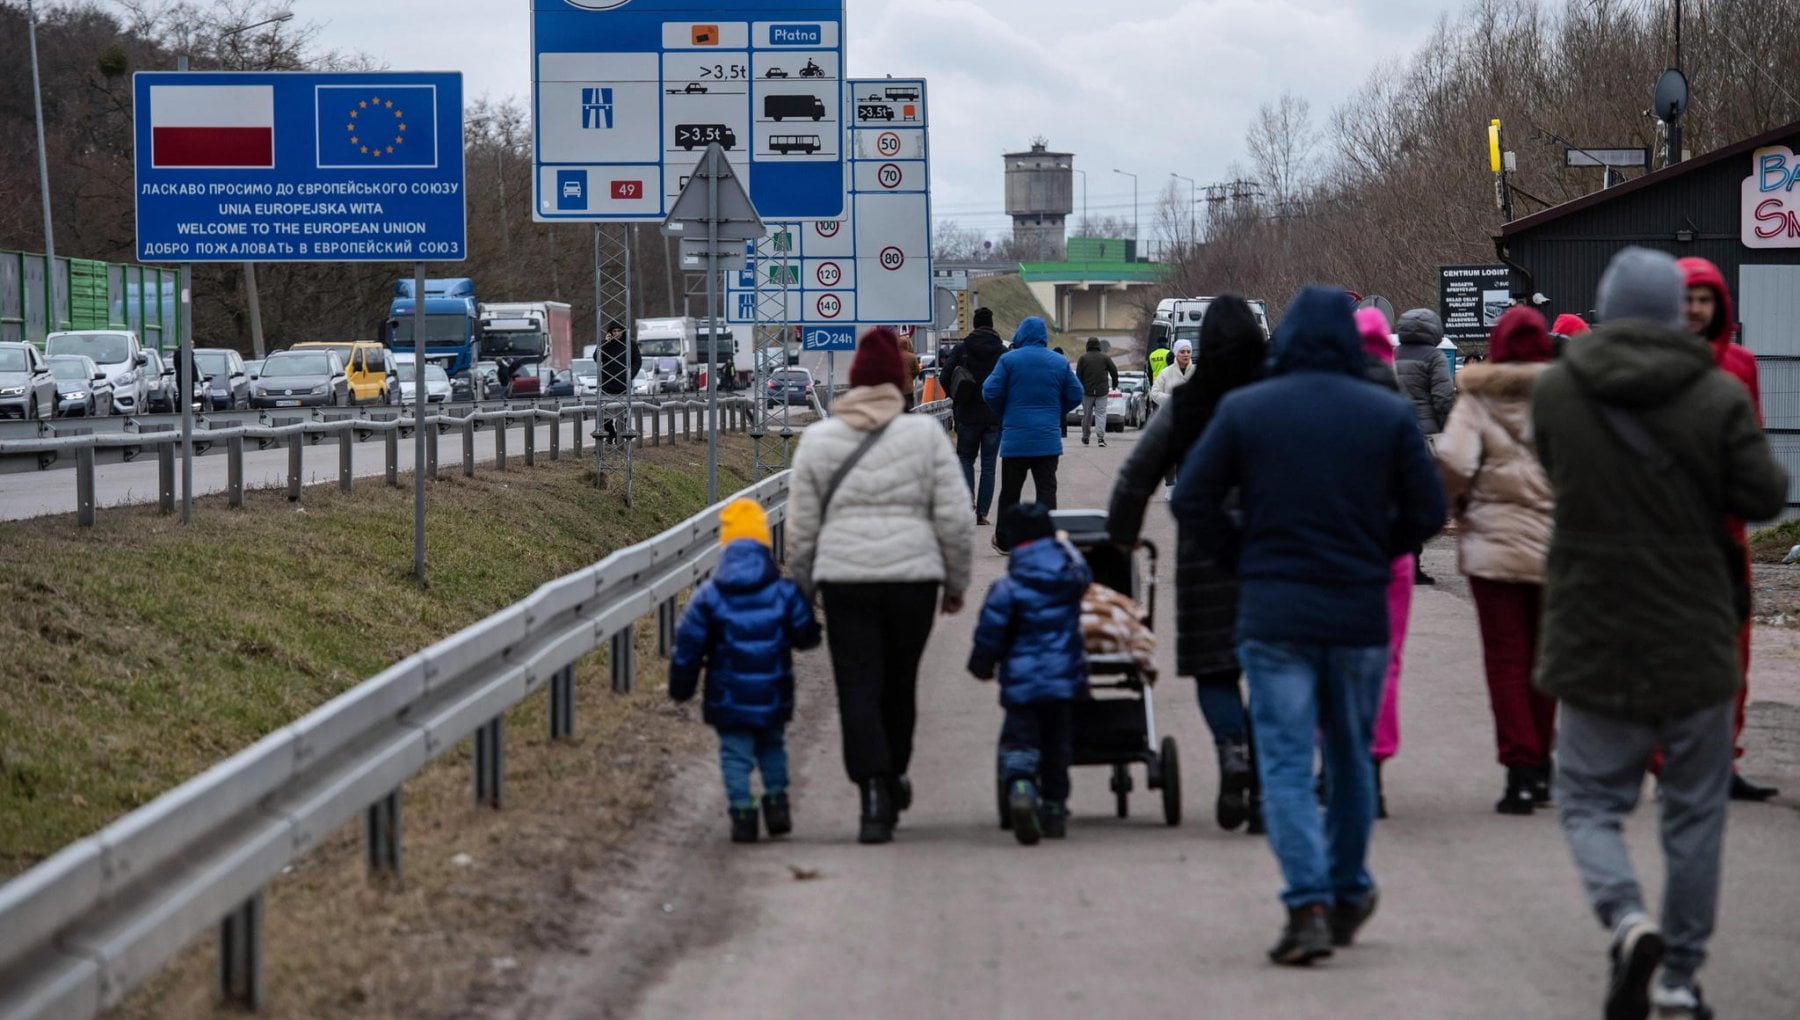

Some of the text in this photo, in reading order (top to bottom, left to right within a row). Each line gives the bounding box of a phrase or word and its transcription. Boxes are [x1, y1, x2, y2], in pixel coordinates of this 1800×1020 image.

[775, 29, 817, 41] Płatna
[881, 137, 897, 150] 50
[883, 170, 897, 182] 70
[142, 181, 458, 196] ЛАСКАВО ПРОСИМО ДО ЄВРОПЕЙСЬКОГО СОЮЗУ
[618, 184, 635, 196] 49
[219, 203, 383, 215] UNIA EUROPEJSKA WITA
[177, 222, 426, 234] WELCOME TO THE EUROPEAN UNION
[144, 240, 458, 255] ДОБРО ПОЖАЛОВАТЬ В ЕВРОПЕЙСКИЙ СОЮЗ
[885, 253, 899, 264] 80
[820, 270, 838, 280] 120
[1443, 268, 1509, 277] CENTRUM LOGIST
[820, 301, 838, 311] 140
[831, 333, 852, 344] 24h
